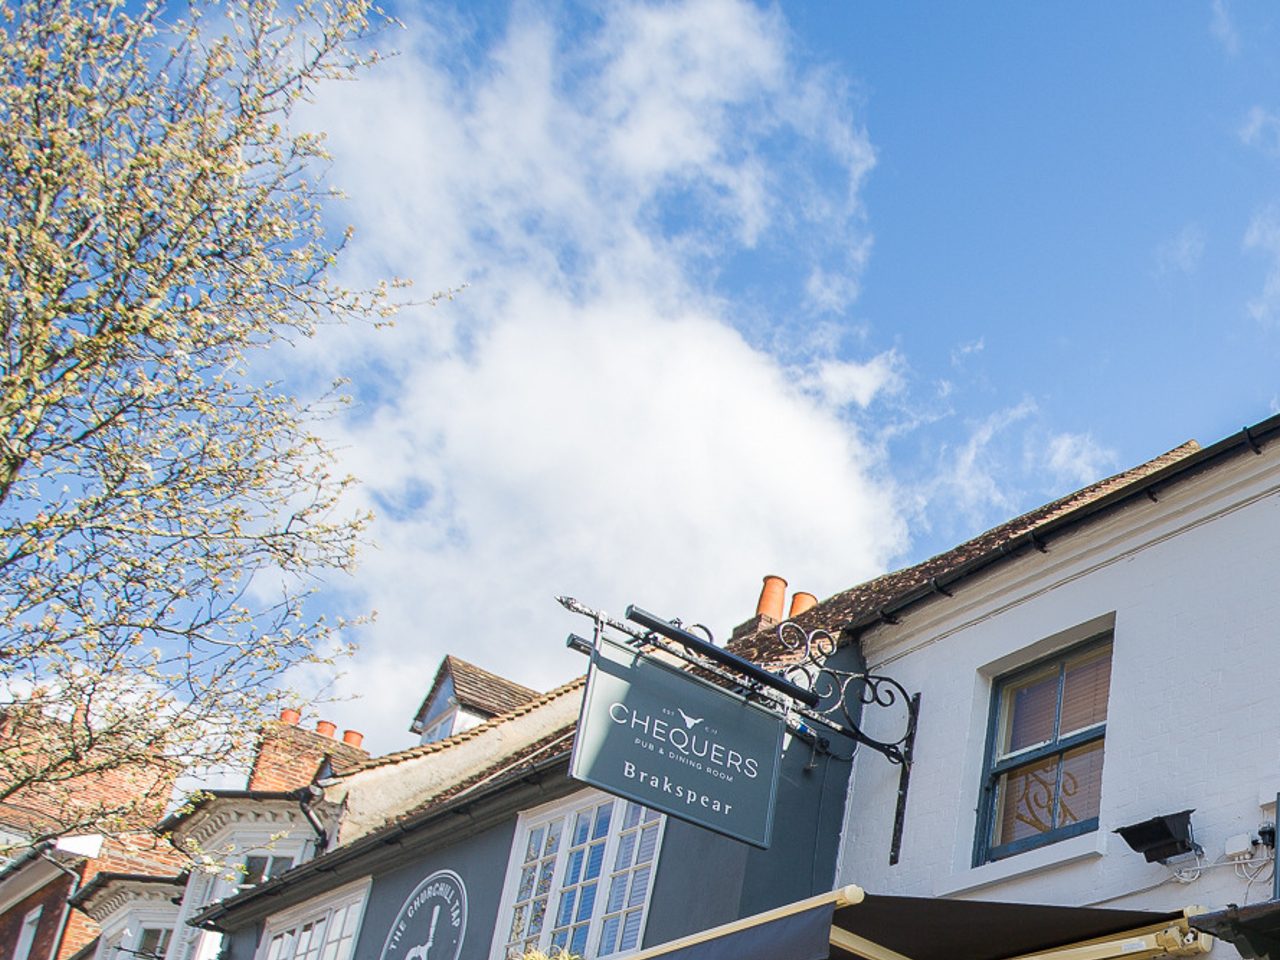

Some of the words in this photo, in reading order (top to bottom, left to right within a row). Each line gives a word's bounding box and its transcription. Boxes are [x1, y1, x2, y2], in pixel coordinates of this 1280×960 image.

[608, 702, 759, 778] CHEQUERS
[634, 738, 655, 752] PUB
[658, 747, 665, 755] &
[669, 751, 702, 770] DINING
[706, 767, 734, 783] ROOM
[623, 760, 733, 815] Brakspear
[389, 920, 407, 950] THE
[407, 882, 455, 918] CHURCHILL
[450, 898, 461, 928] TAP
